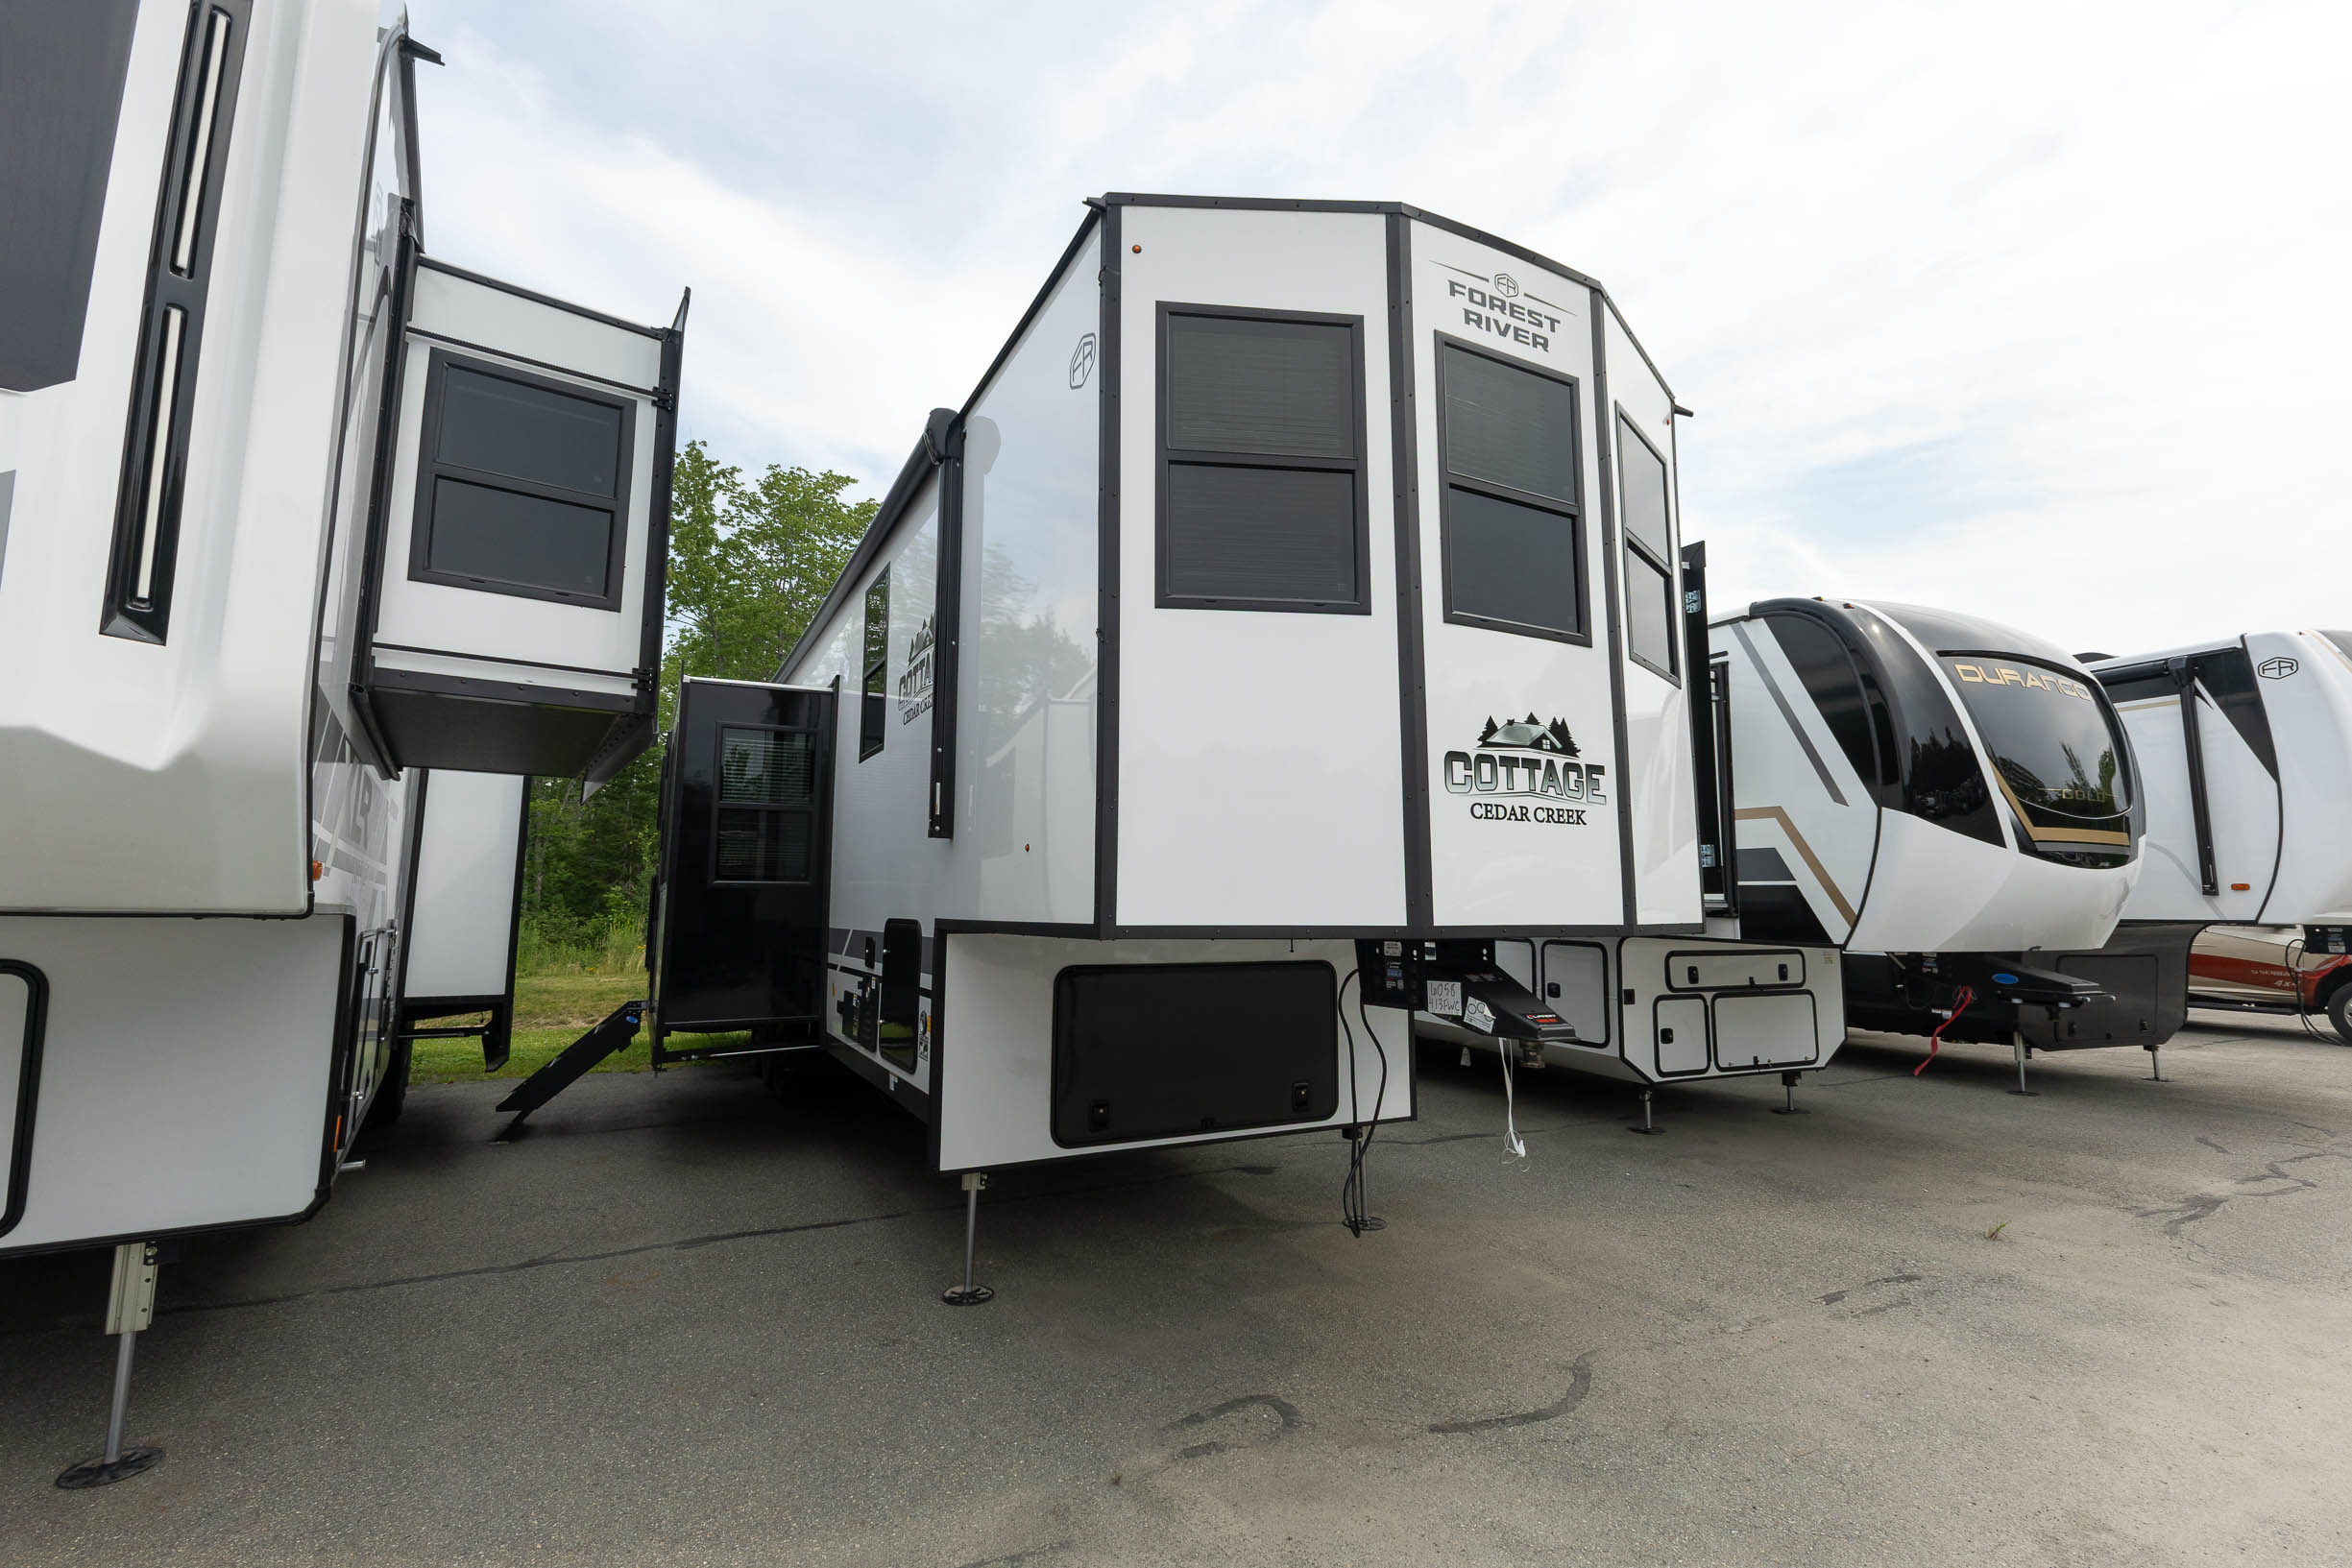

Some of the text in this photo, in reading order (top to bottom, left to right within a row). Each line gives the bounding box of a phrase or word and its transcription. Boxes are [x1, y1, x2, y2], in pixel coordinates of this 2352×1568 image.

[1447, 279, 1561, 333] FOREST
[1463, 307, 1549, 352] RIVER
[898, 652, 934, 709] COTTA
[1953, 663, 2091, 701] DURANGO
[903, 692, 934, 725] CEDAR CRE
[1443, 750, 1607, 805] COTTAGE
[2062, 788, 2106, 802] GOLD
[1470, 802, 1587, 825] CEDAR CREEK
